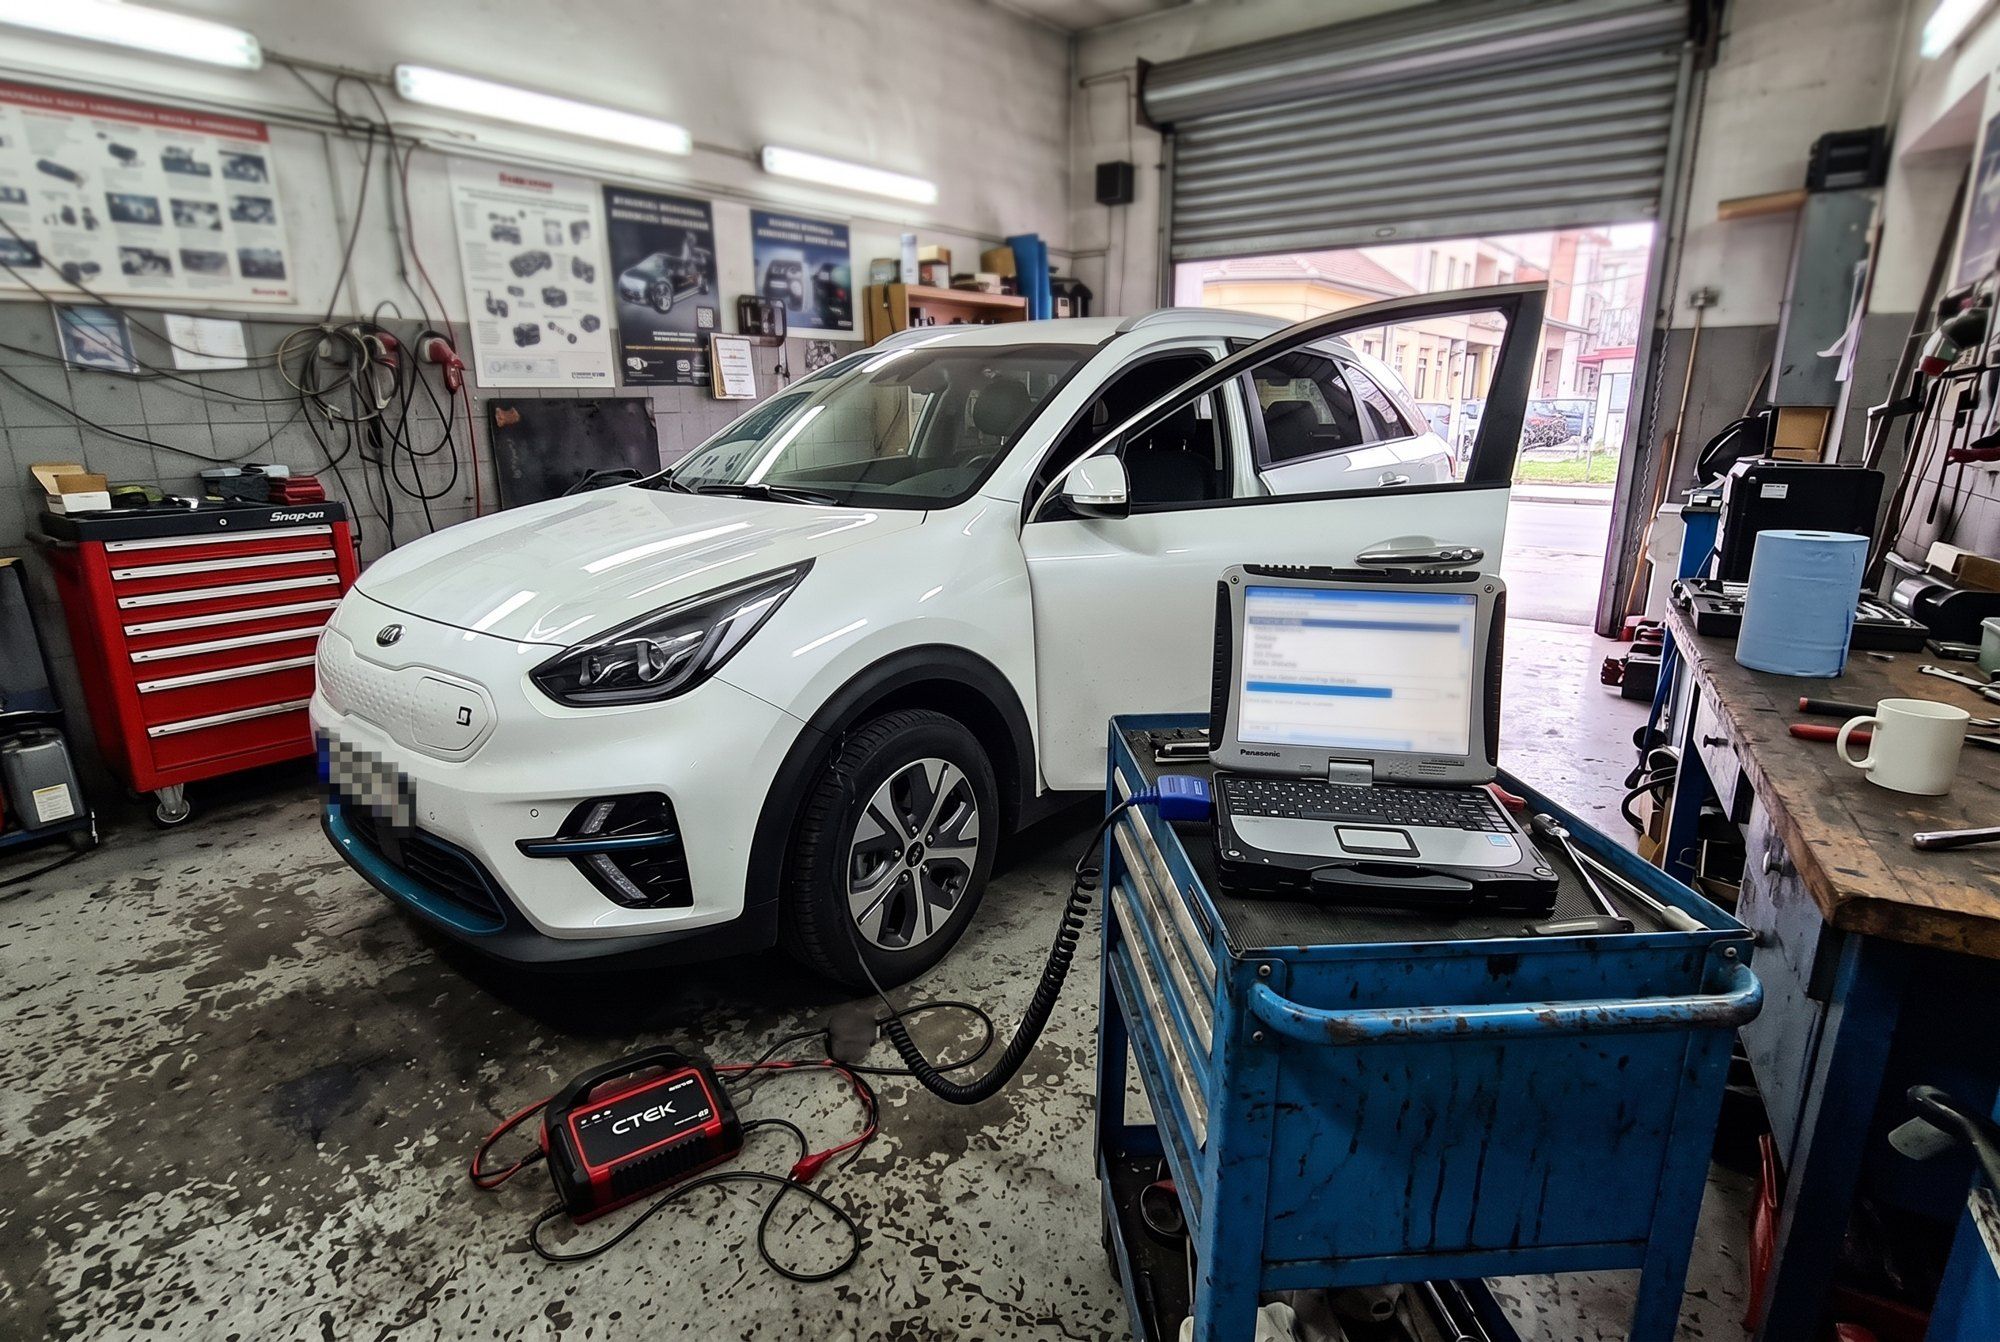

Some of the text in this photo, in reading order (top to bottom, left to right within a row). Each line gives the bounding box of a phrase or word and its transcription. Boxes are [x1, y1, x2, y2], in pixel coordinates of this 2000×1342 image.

[270, 511, 324, 522] Snap-on
[378, 626, 400, 642] KIA
[1240, 749, 1280, 757] Panasonic
[611, 1100, 677, 1135] CTEK
